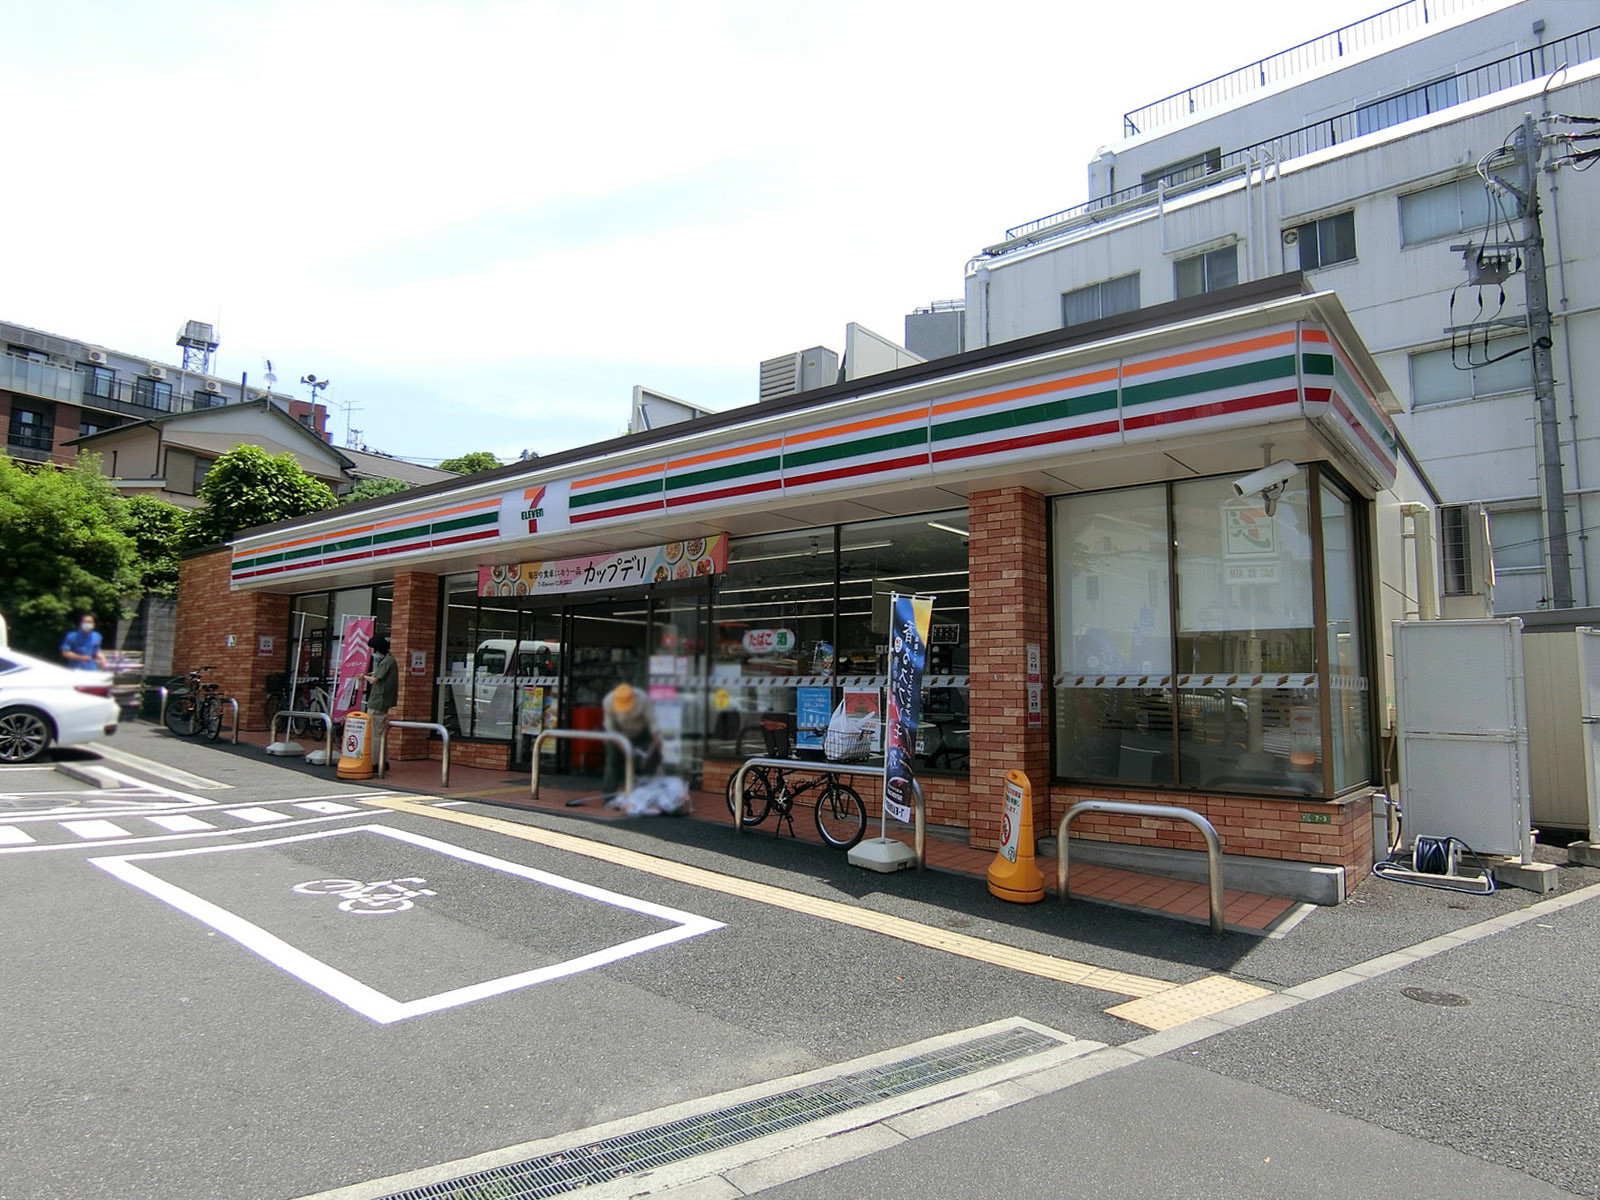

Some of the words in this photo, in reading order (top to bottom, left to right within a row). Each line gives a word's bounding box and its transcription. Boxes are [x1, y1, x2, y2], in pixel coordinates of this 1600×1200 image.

[523, 485, 546, 533] 7
[584, 555, 647, 585] カップデリ
[749, 632, 773, 646] たばこ
[776, 631, 788, 646] 酒
